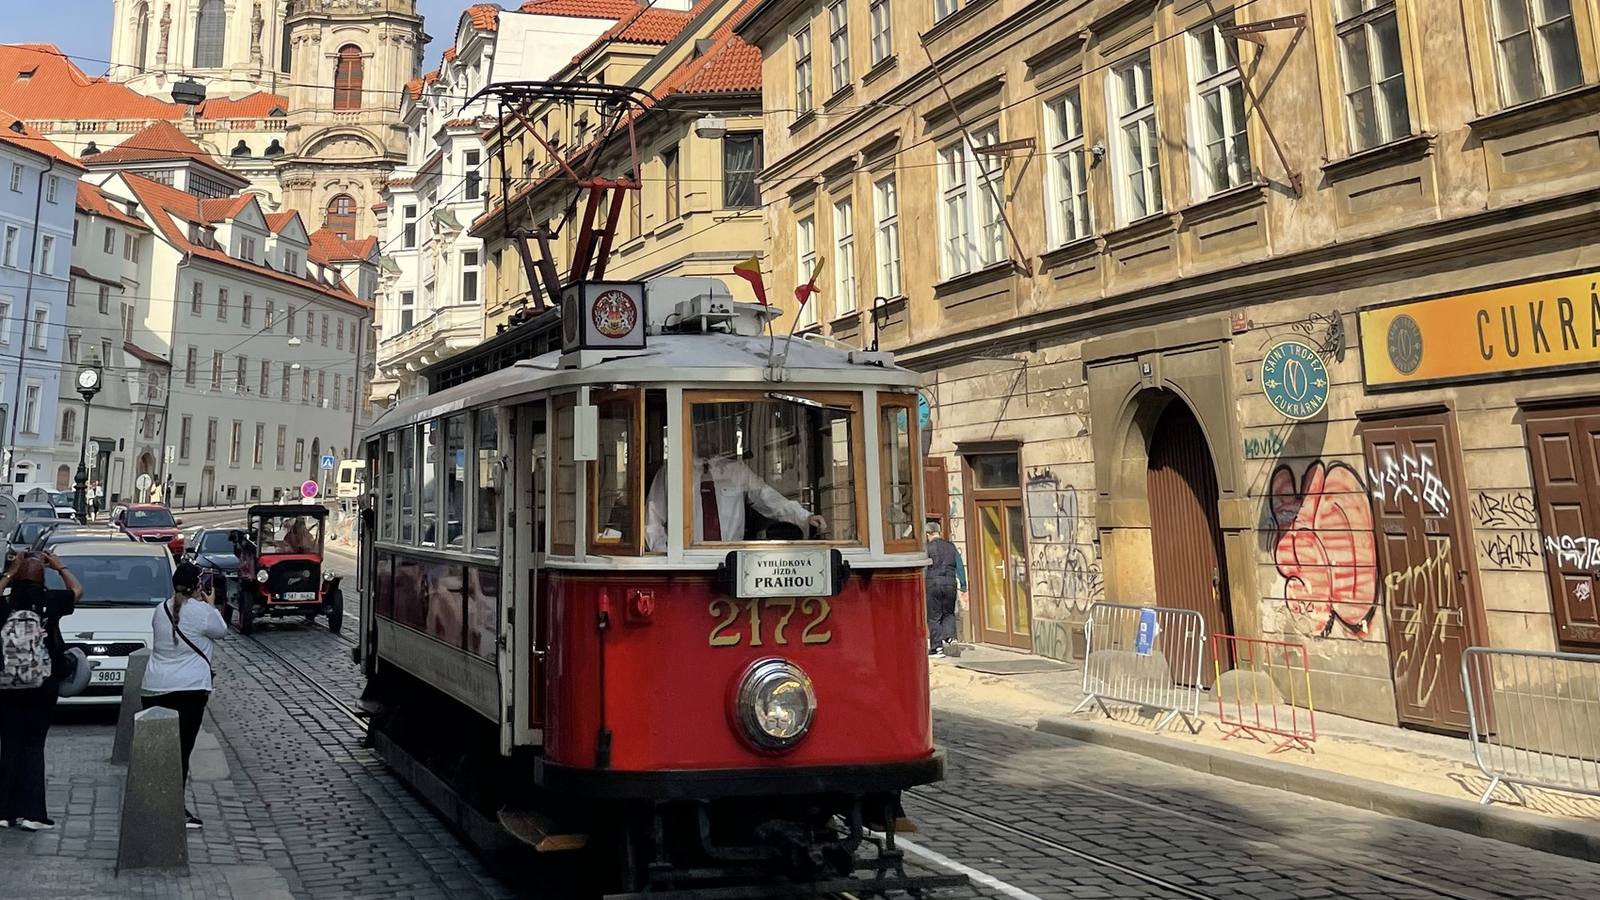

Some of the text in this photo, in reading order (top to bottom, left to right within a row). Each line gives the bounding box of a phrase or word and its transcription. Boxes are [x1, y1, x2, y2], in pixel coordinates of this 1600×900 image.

[1265, 344, 1323, 373] SAINT TROPEZ
[772, 567, 797, 575] JÍZDA
[755, 576, 814, 588] PRAHOU
[708, 597, 831, 646] 2172
[98, 671, 121, 681] 9803
